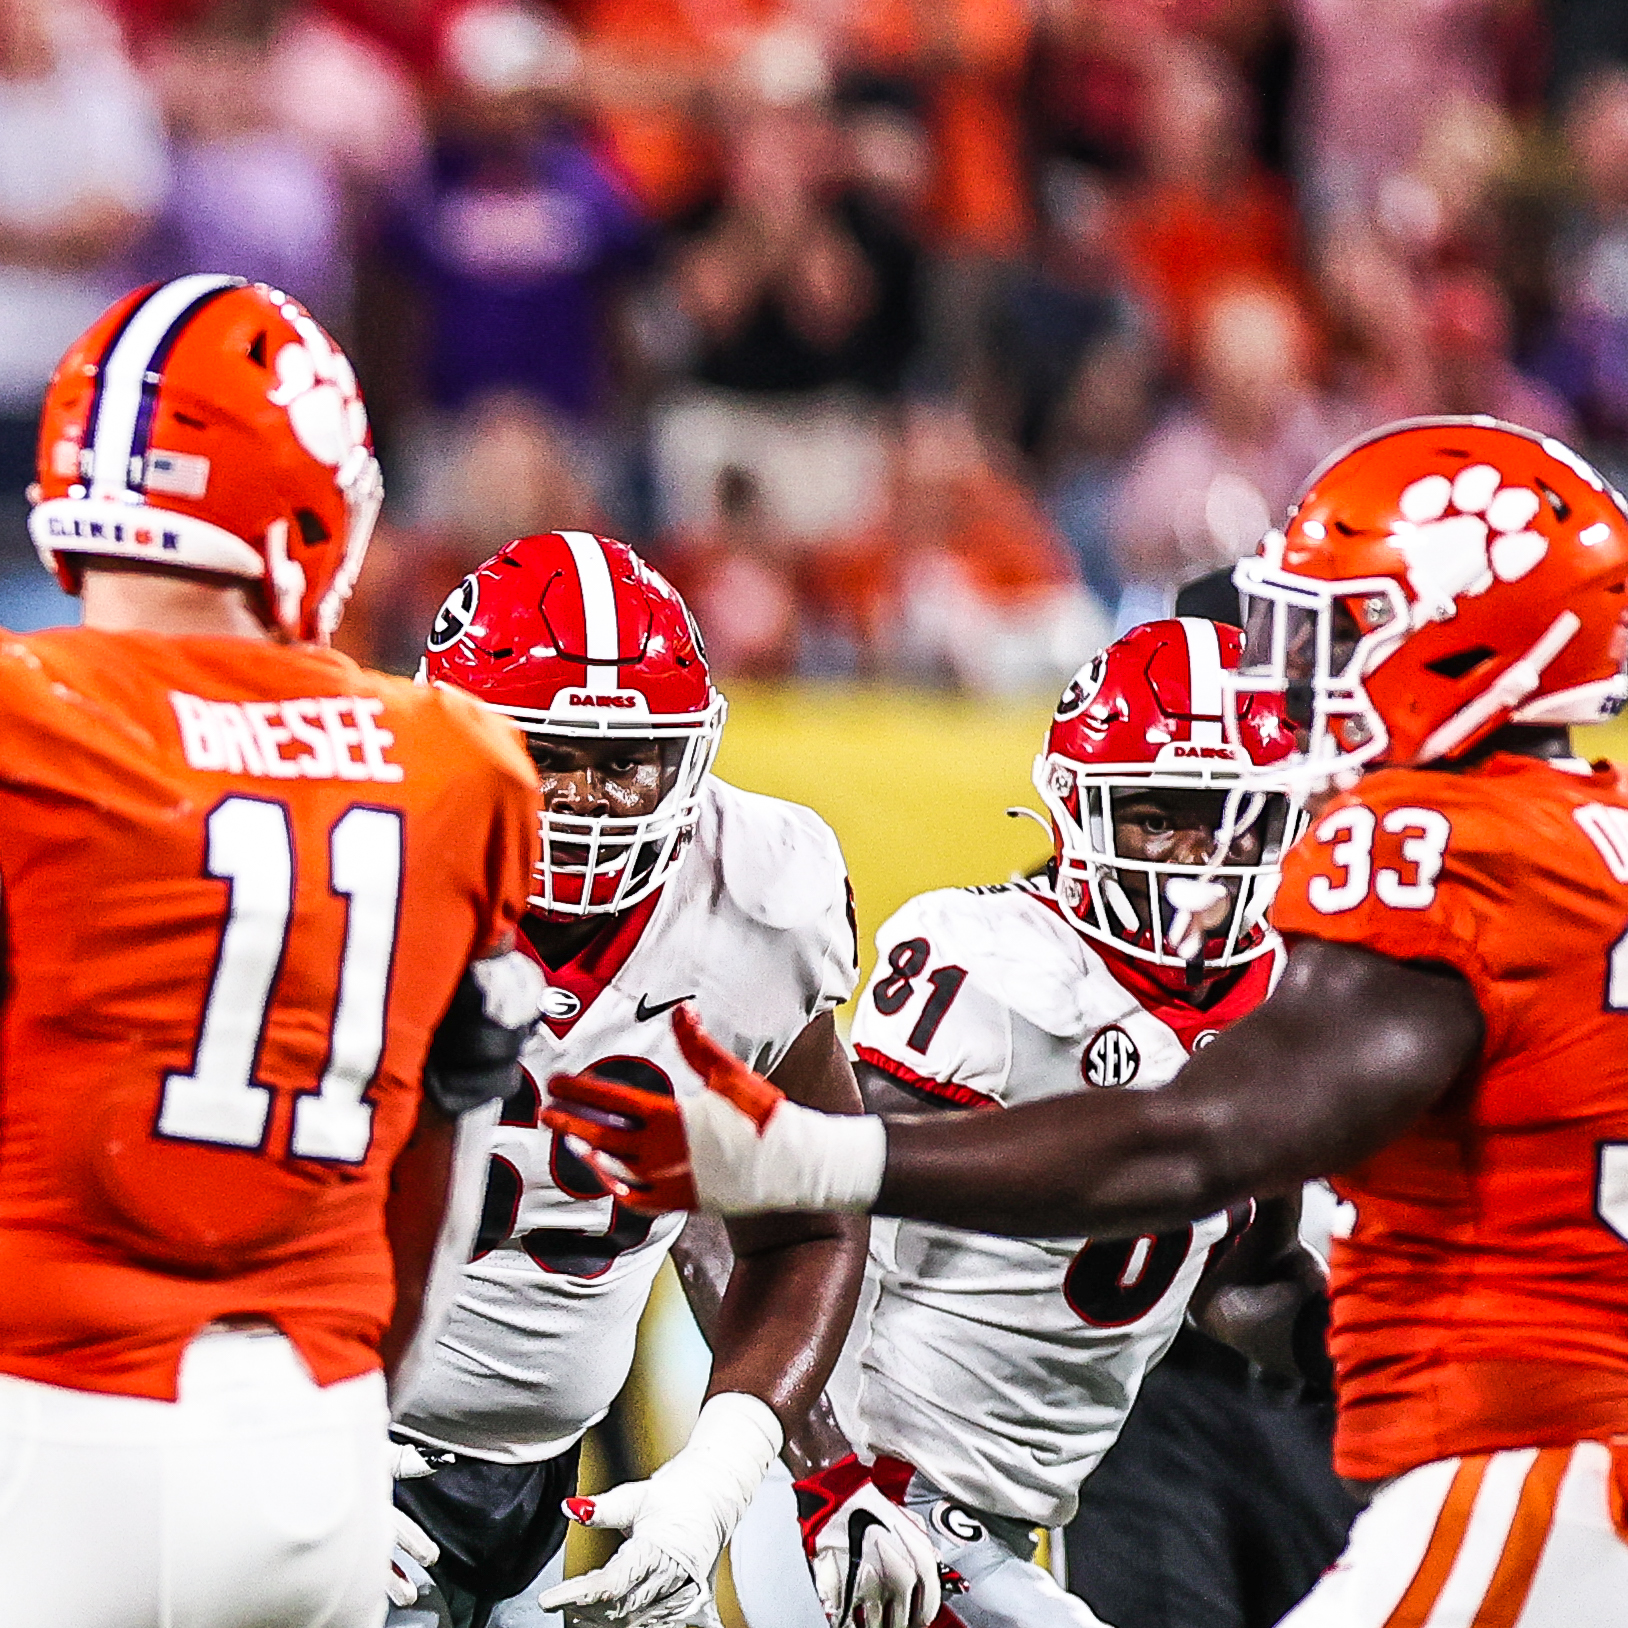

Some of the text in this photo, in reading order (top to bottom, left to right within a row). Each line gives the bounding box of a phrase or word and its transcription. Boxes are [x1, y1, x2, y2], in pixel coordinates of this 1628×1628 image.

[168, 690, 404, 783] BRESEE
[568, 693, 637, 709] DAWGS
[1308, 804, 1452, 915] 33
[154, 793, 405, 1165] 11
[872, 936, 969, 1056] 81
[1088, 1028, 1138, 1088] SEC
